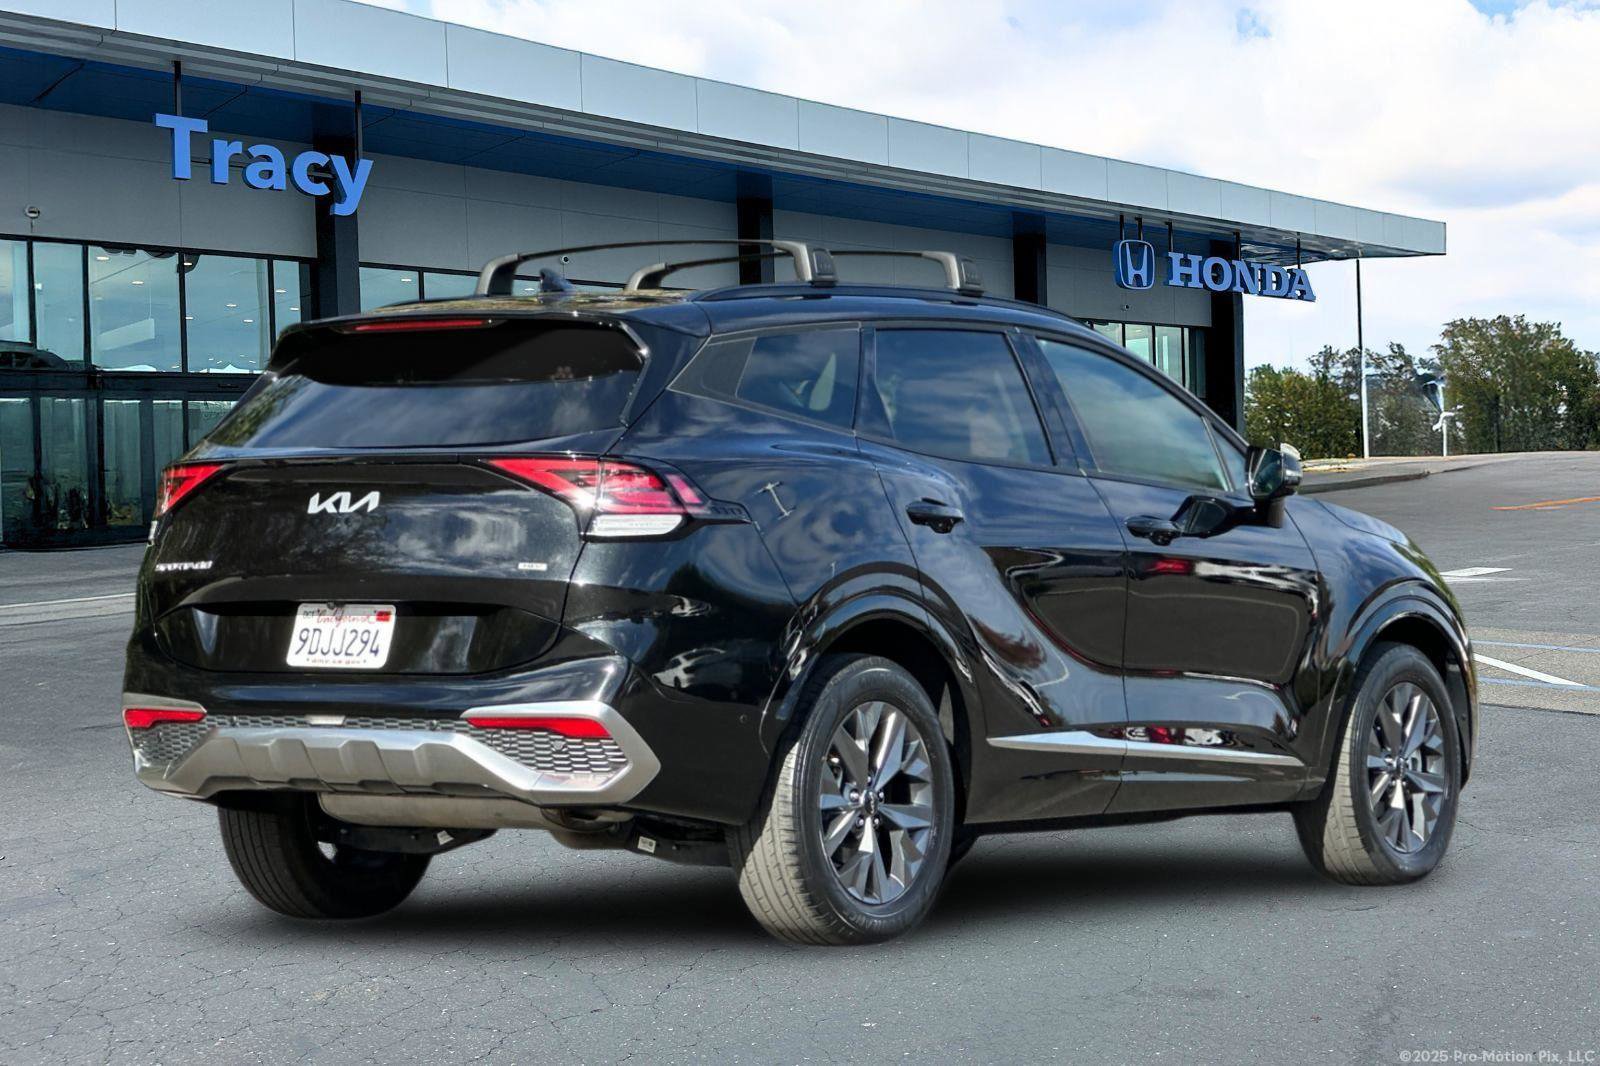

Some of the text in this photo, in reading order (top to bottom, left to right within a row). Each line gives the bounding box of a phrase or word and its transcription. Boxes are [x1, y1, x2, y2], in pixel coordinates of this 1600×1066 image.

[155, 113, 374, 216] Tracy
[1167, 251, 1316, 301] HONDA
[307, 491, 380, 514] KIA
[295, 628, 379, 656] 9DJJ294
